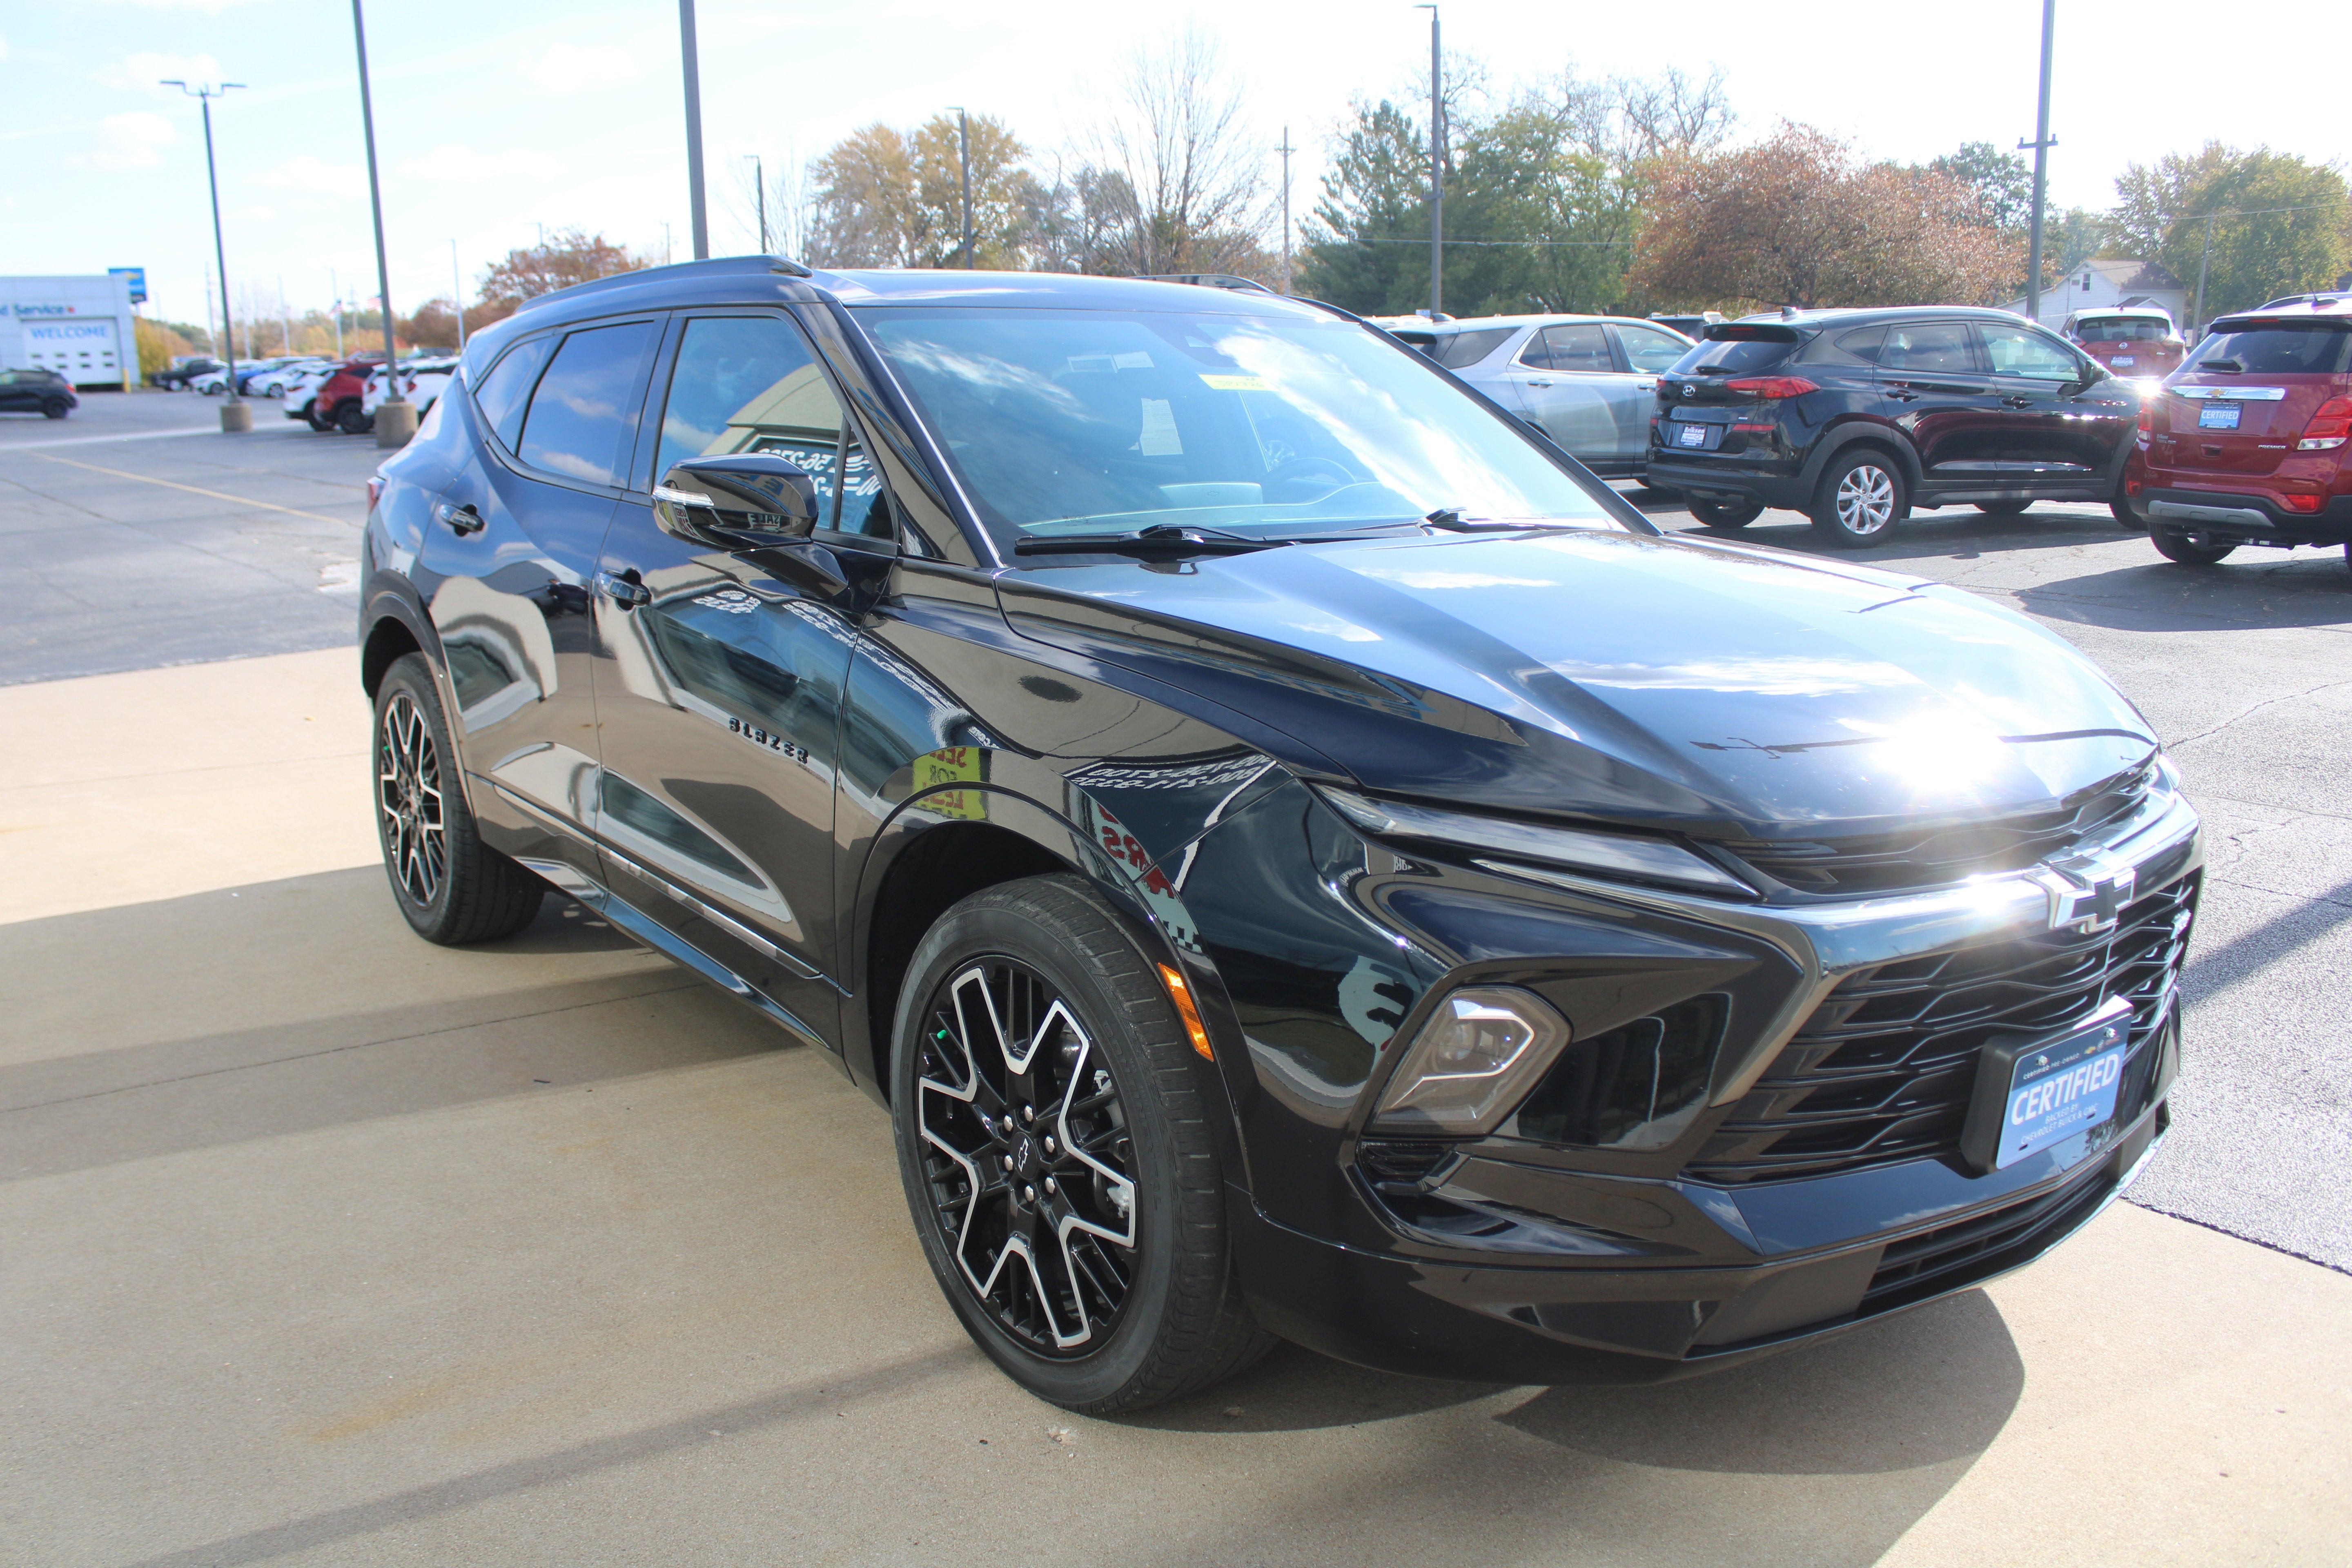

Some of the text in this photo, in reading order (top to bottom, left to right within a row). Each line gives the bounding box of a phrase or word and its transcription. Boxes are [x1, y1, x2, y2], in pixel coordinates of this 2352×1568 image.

[31, 326, 107, 339] WELCOME
[2201, 410, 2239, 420] CERTIFIED
[729, 717, 808, 764] BLAZER
[2011, 1054, 2120, 1125] CERTIFIED
[2045, 1102, 2079, 1124] BACKED BY
[2021, 1122, 2057, 1145] CHEVROLET
[2058, 1114, 2076, 1128] BUICK
